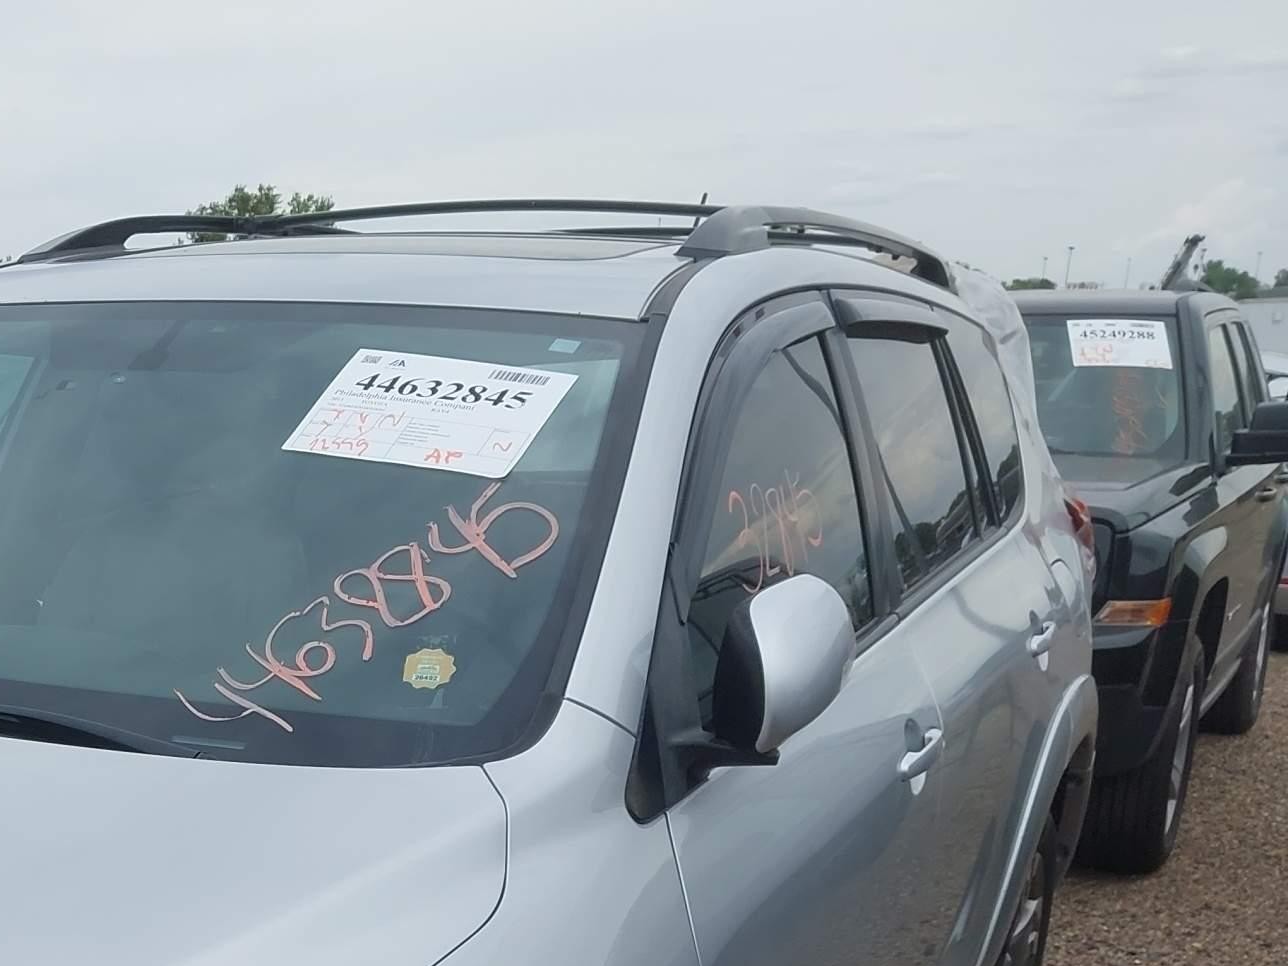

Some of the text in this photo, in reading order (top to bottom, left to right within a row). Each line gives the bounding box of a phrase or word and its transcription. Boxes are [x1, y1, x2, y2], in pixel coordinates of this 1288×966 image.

[1080, 329, 1157, 340] 45249288
[334, 388, 389, 402] Philadelphia
[355, 372, 534, 410] 44632845
